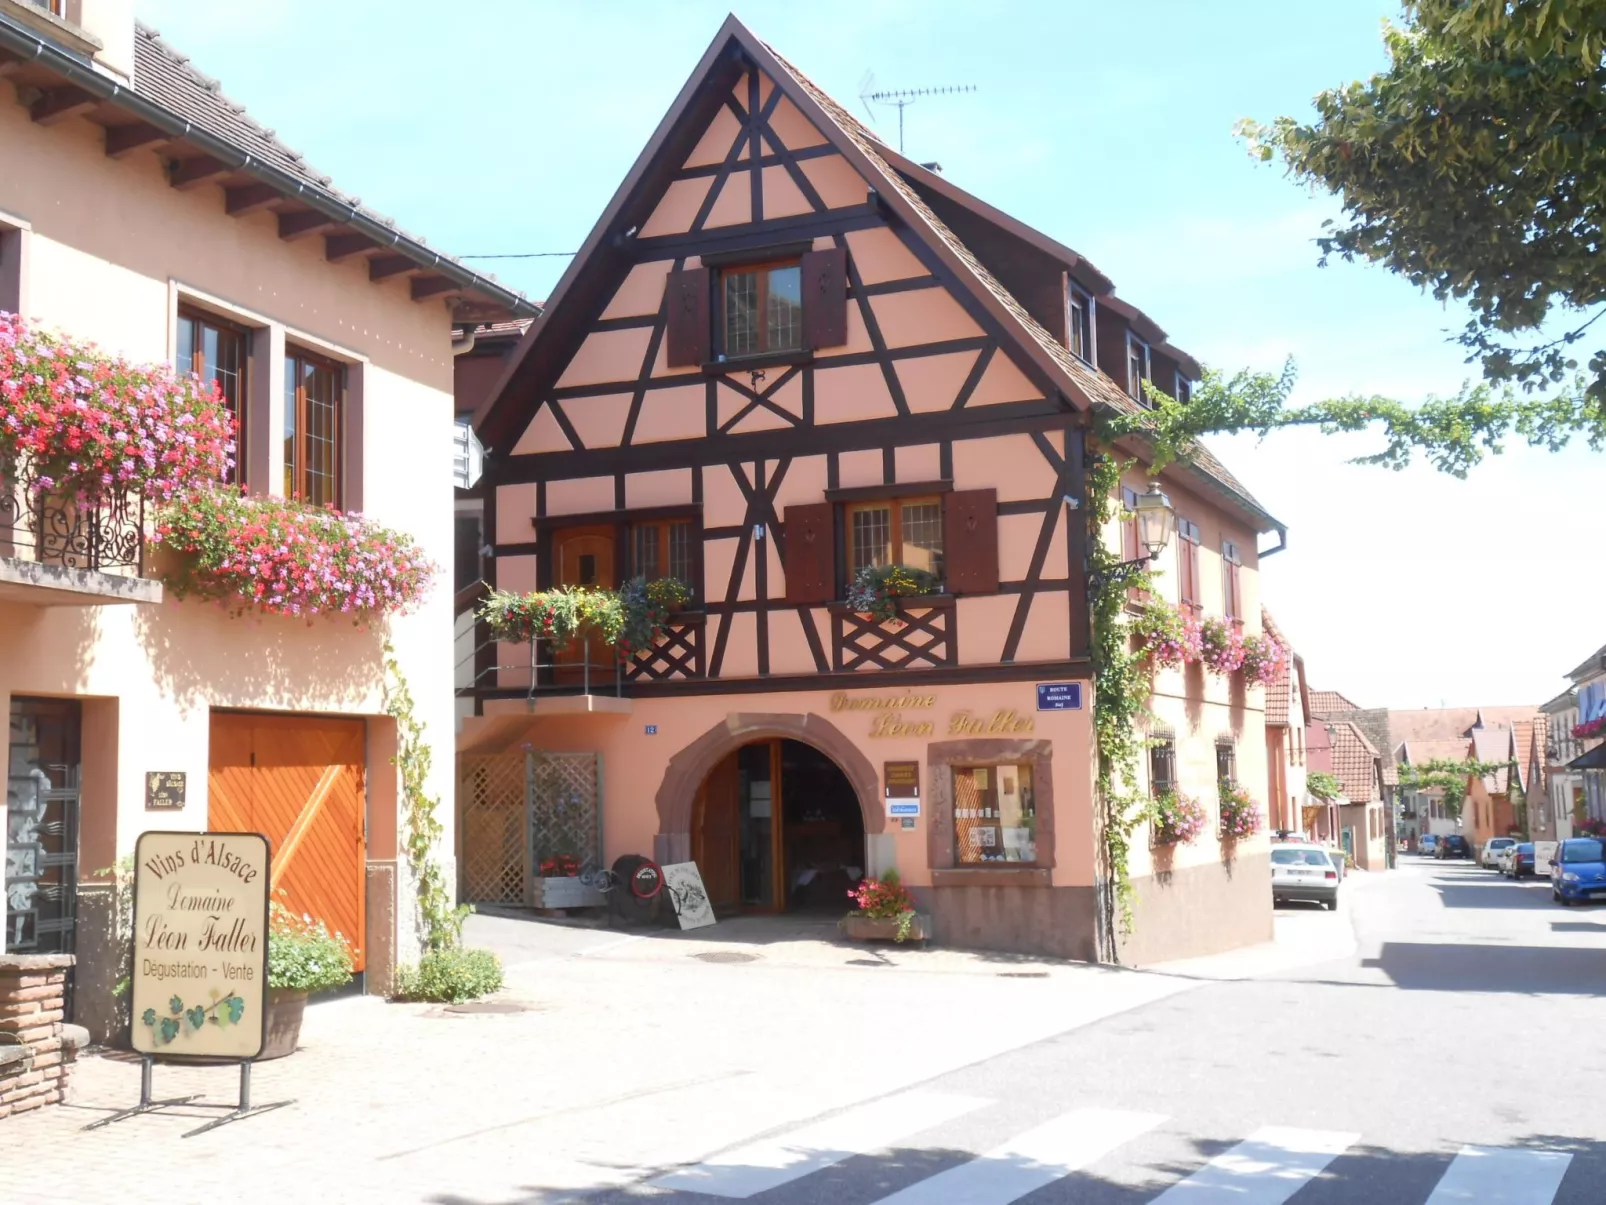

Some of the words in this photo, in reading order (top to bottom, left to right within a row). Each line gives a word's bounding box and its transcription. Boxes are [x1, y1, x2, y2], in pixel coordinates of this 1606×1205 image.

[829, 689, 936, 713] Domaine
[868, 711, 935, 738] Léon
[948, 709, 1035, 734] Faller
[145, 850, 185, 880] Vins
[191, 840, 257, 883] d'Alsace
[167, 882, 234, 912] Domaine
[144, 914, 187, 951] Léon
[198, 915, 256, 952] Faller
[143, 958, 207, 981] Dégustation
[222, 962, 254, 980] Vente
